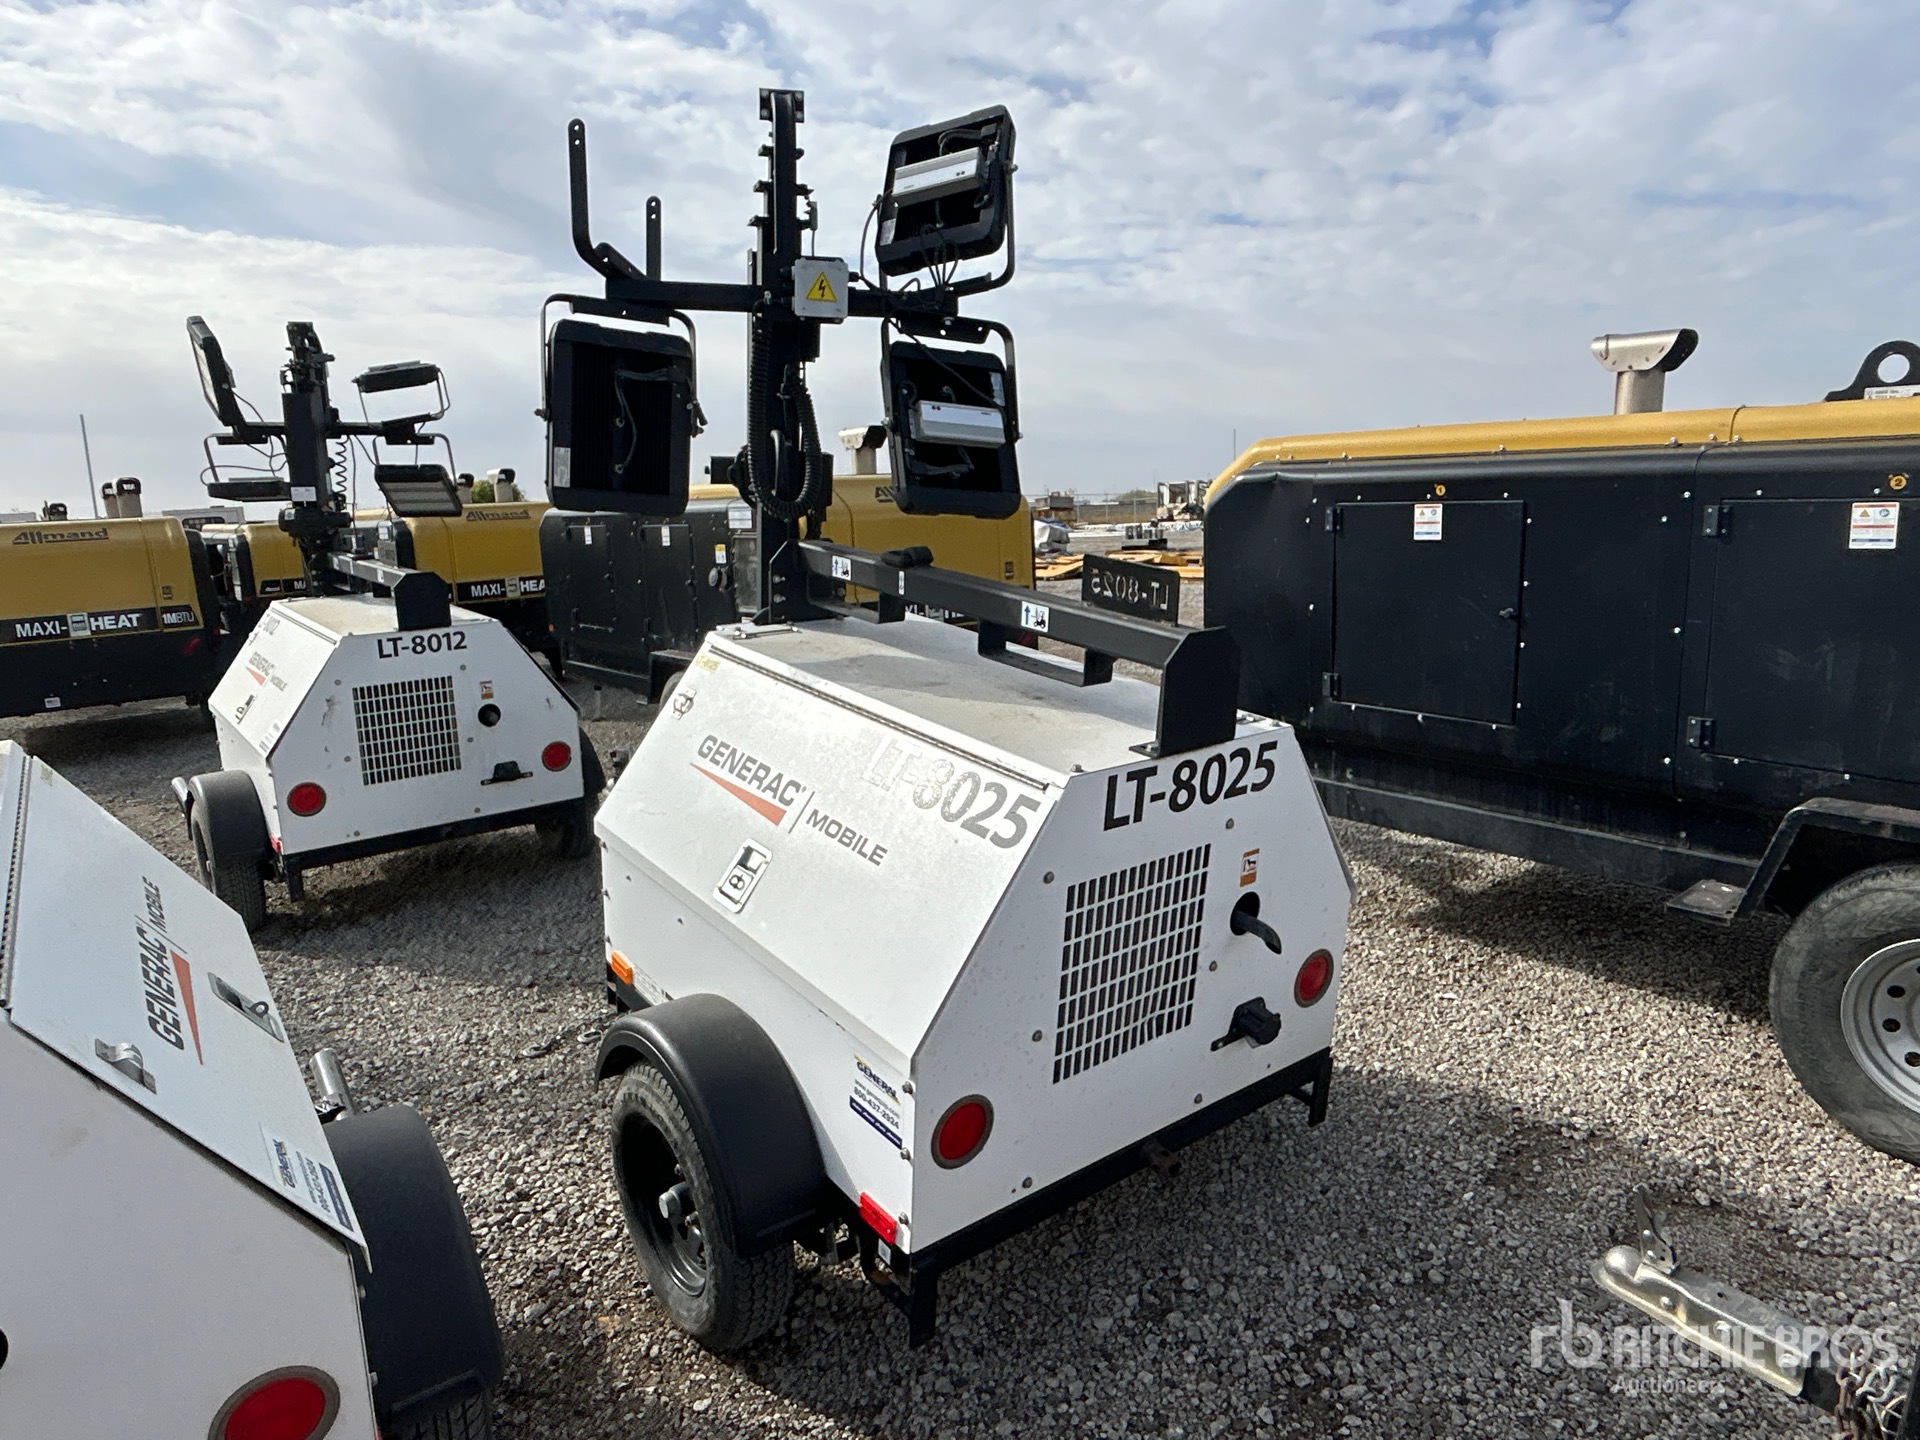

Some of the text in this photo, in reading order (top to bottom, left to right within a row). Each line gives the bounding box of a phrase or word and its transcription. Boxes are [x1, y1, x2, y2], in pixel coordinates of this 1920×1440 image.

[12, 528, 109, 545] Allmand
[466, 509, 531, 521] Allmand
[90, 613, 140, 631] HEAT
[377, 631, 467, 659] LT-8012
[697, 734, 889, 866] GENERAC MOBILE
[860, 730, 1042, 849] LT-8025
[1103, 740, 1278, 831] LT-8025
[136, 875, 185, 1050] GENERAC MOBILE
